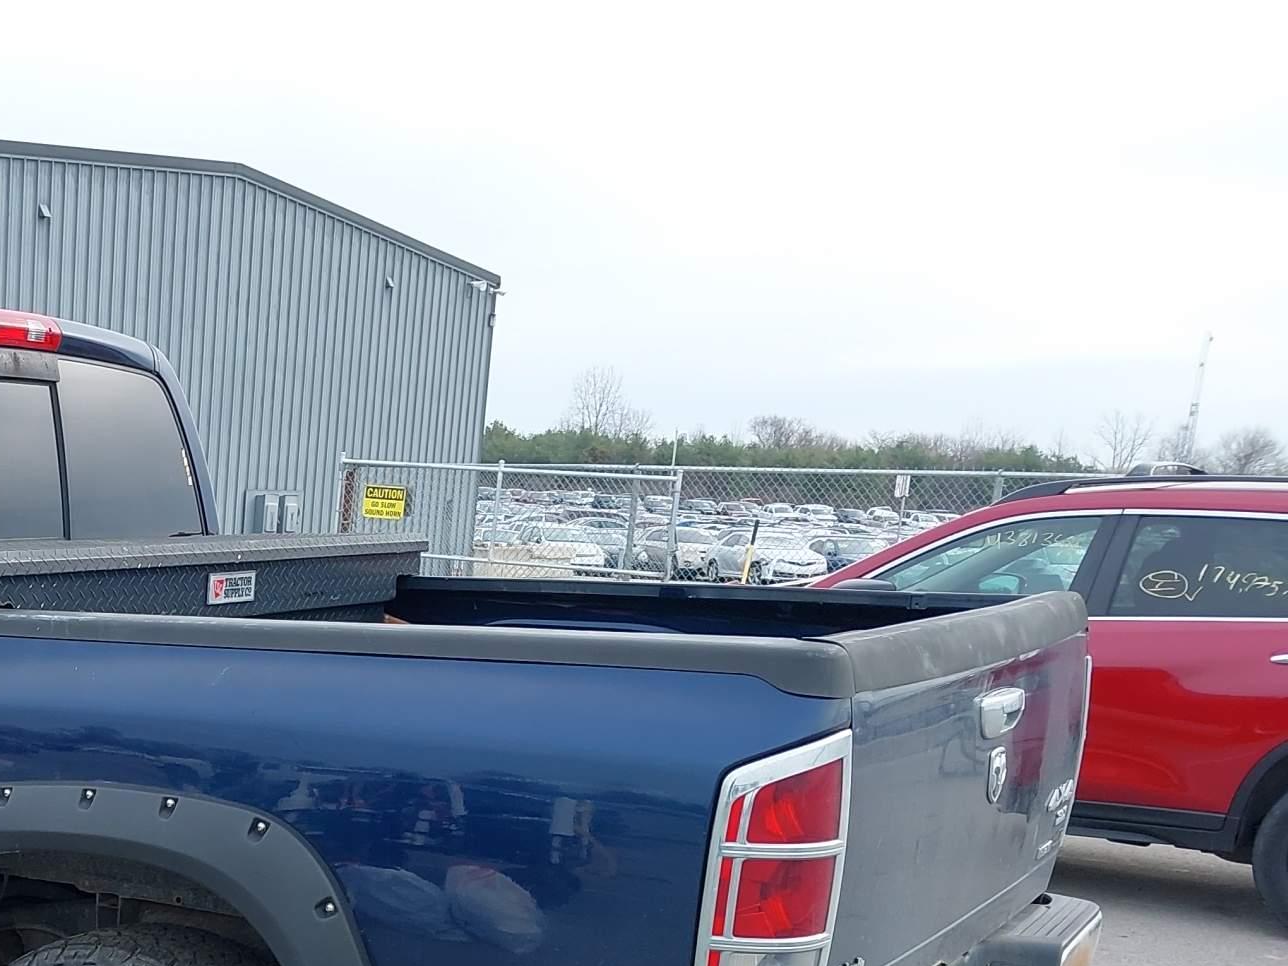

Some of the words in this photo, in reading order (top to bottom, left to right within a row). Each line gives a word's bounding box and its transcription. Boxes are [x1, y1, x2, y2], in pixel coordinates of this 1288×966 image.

[366, 487, 404, 500] CAUTION
[364, 508, 384, 516] SOUND
[385, 510, 402, 518] HORN
[224, 576, 253, 588] TRACTOR
[223, 587, 244, 599] SUPPLY
